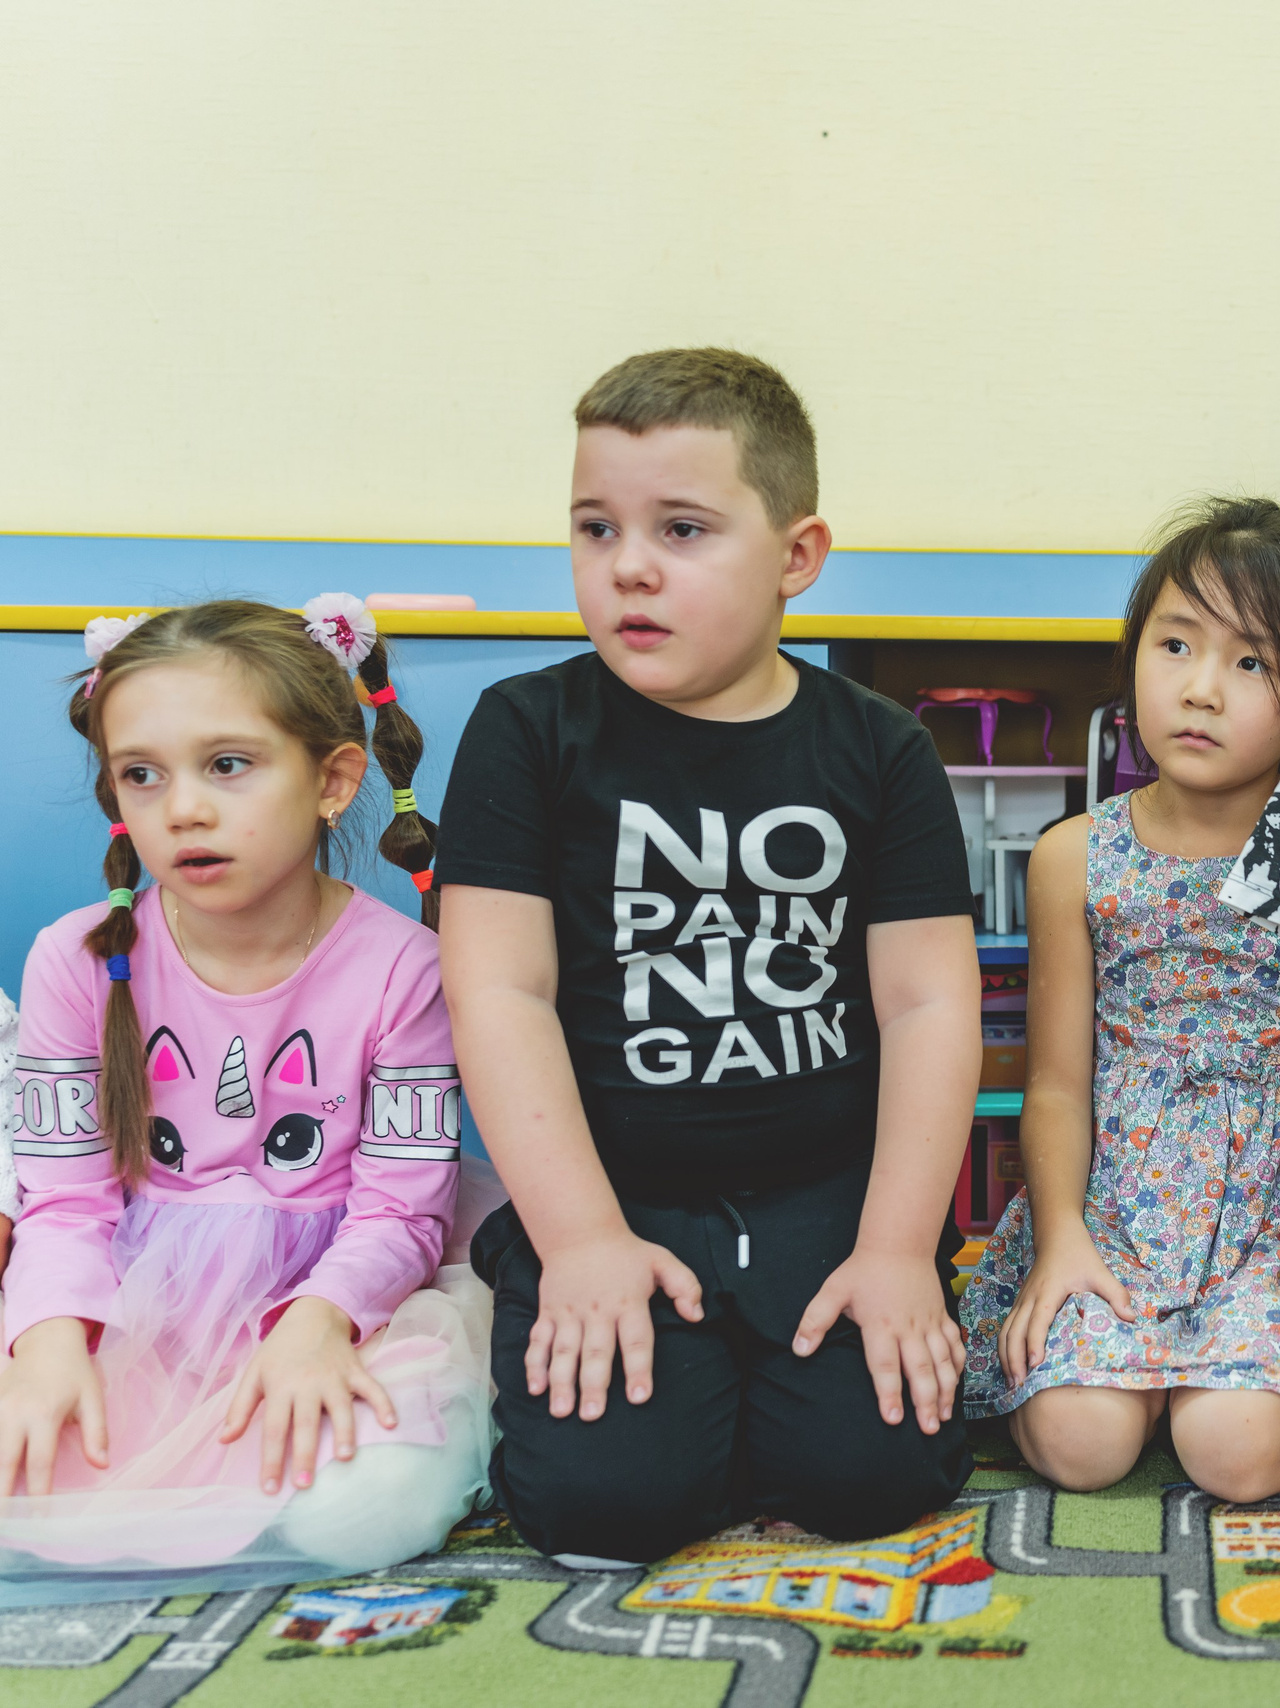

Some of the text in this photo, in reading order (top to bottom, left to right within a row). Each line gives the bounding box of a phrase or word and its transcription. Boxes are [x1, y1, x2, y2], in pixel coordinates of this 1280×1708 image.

[614, 799, 848, 894] NO
[613, 891, 848, 951] PAIN
[616, 937, 838, 1022] NO
[623, 1002, 848, 1085] GAIN
